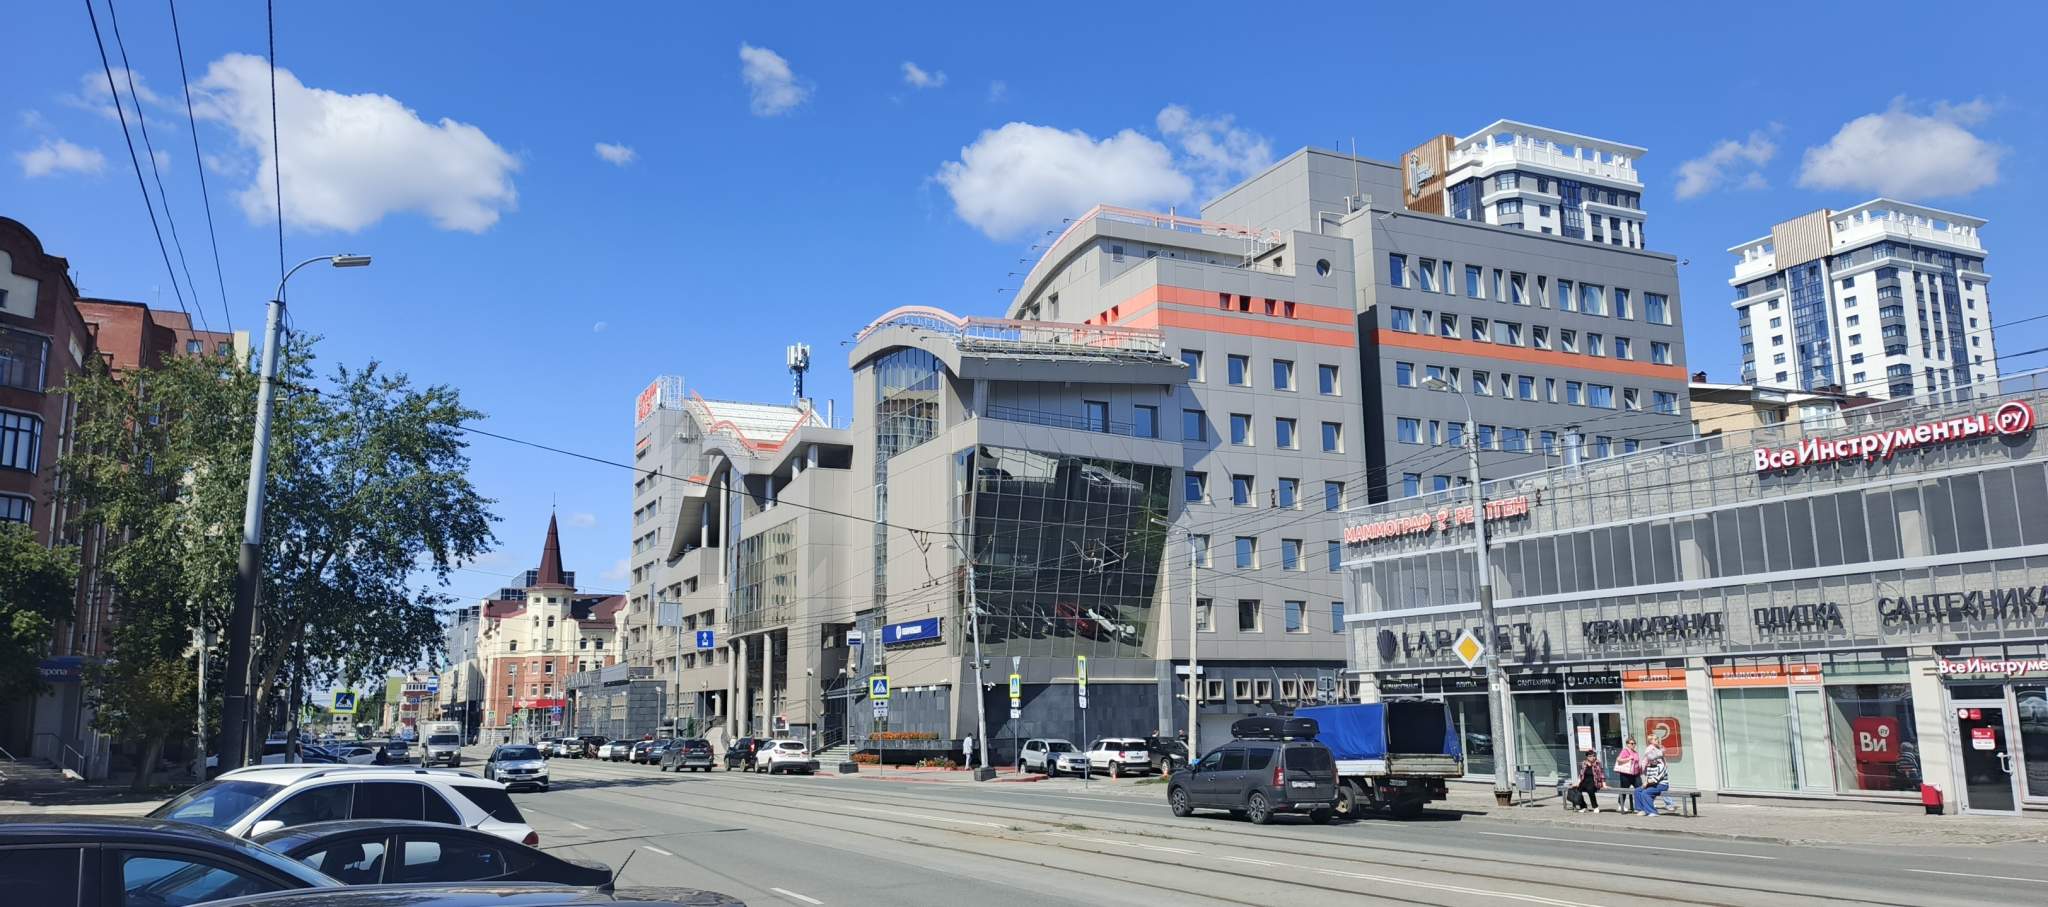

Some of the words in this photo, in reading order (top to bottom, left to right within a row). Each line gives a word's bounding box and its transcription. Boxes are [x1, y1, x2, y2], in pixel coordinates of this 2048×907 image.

[1344, 512, 1432, 544] МАММОГРАФ
[1455, 495, 1529, 525] РЕТГЕН
[1753, 602, 1843, 628] ПЛИТКА
[1878, 586, 2048, 621] САНТЕХНИКА
[1402, 622, 1531, 658] LAPET
[1582, 611, 1724, 640] КЕРАМОГРАНИТ
[1577, 676, 1620, 685] LAPARET
[1860, 731, 1887, 752] Ви
